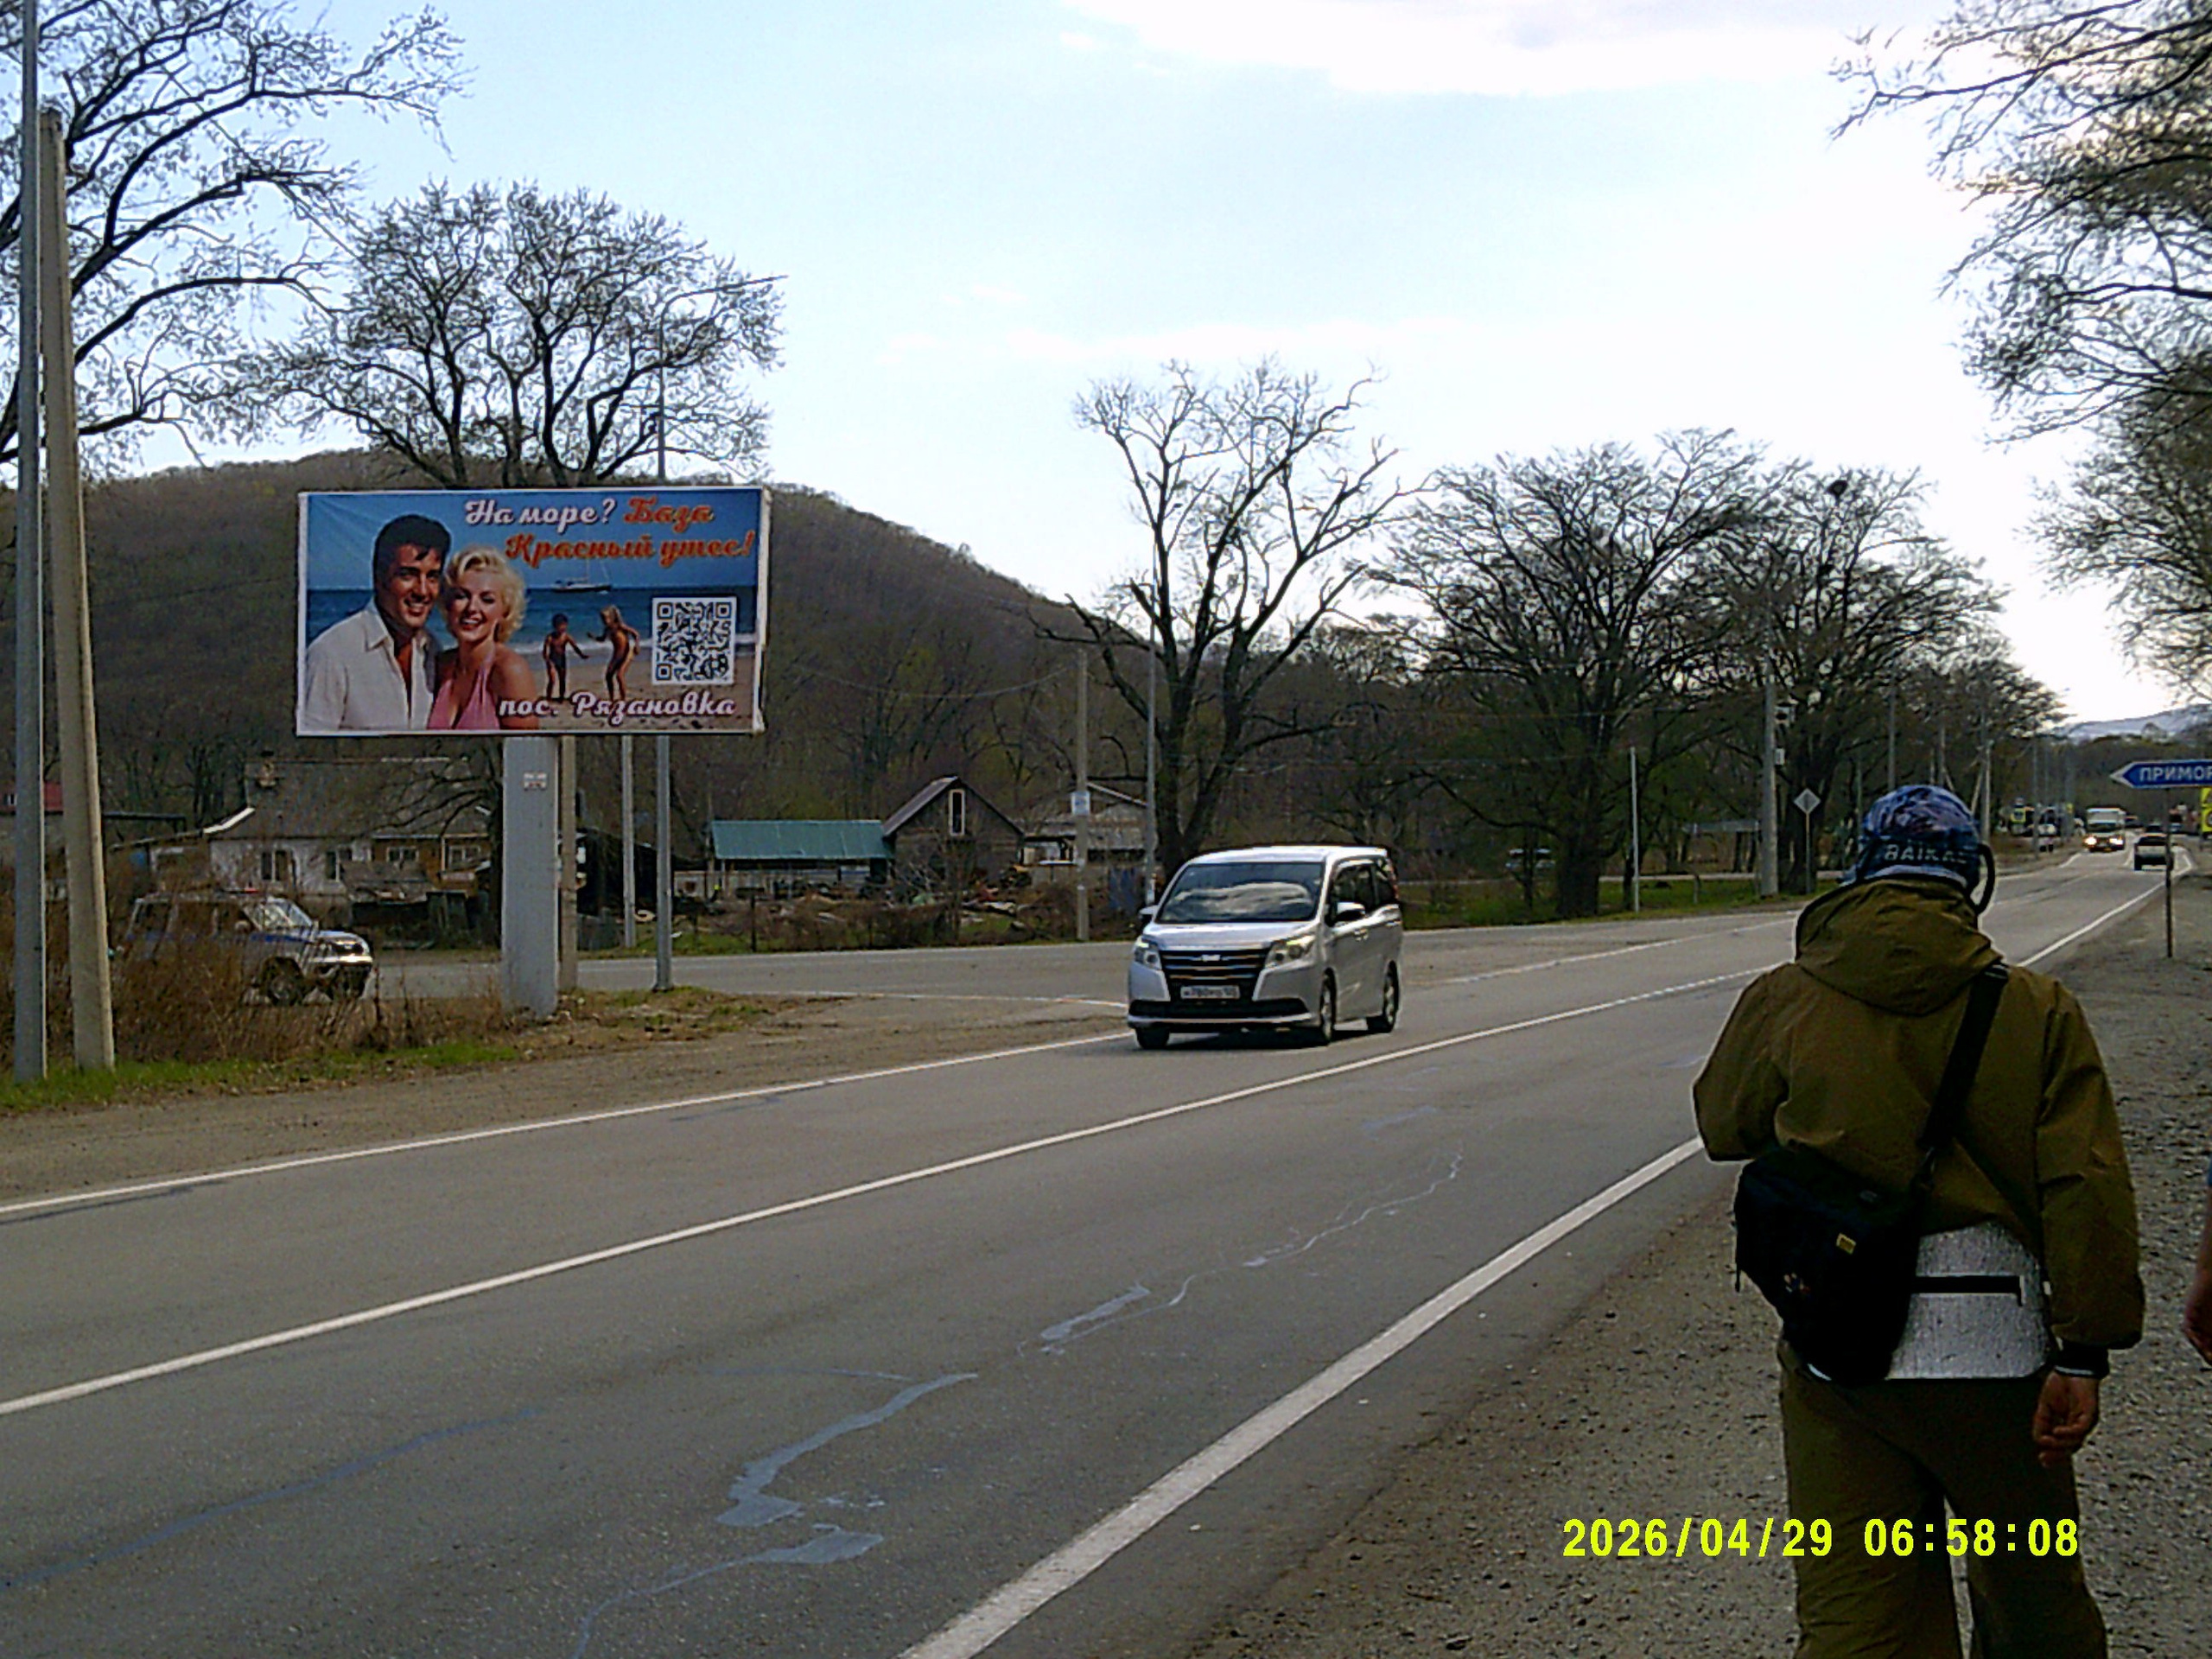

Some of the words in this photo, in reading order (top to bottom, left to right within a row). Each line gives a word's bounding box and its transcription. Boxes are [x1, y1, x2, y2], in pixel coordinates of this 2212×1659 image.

[464, 499, 512, 524] На
[518, 498, 616, 534] море?
[623, 496, 715, 533] База
[505, 532, 655, 569] Красный
[659, 530, 756, 568] утес!
[499, 696, 560, 715] пос.
[571, 690, 736, 725] Рязановка
